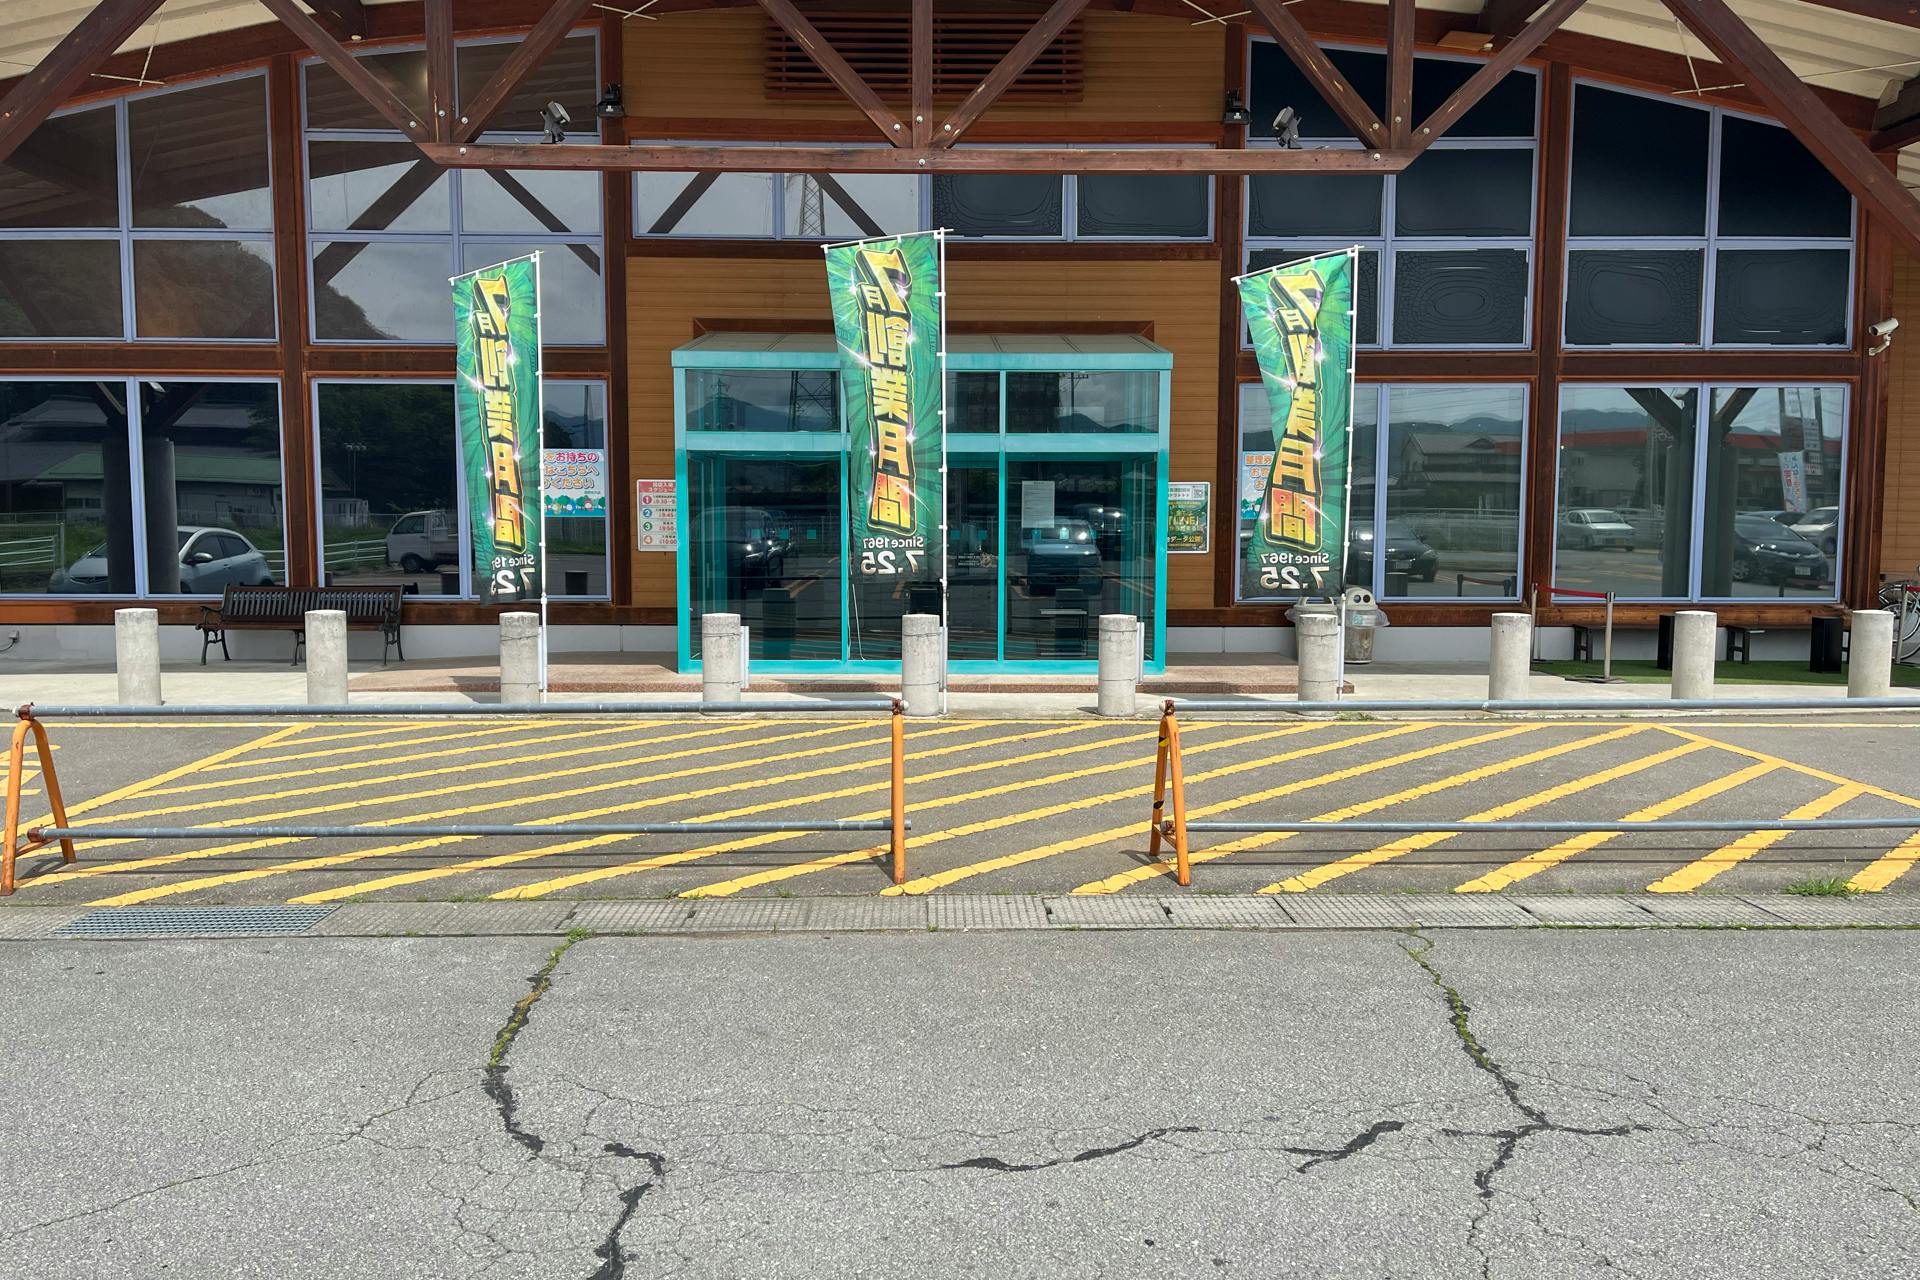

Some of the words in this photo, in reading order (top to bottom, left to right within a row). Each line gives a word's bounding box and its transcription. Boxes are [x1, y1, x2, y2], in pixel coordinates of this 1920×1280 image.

[544, 450, 599, 463] をお持ちの
